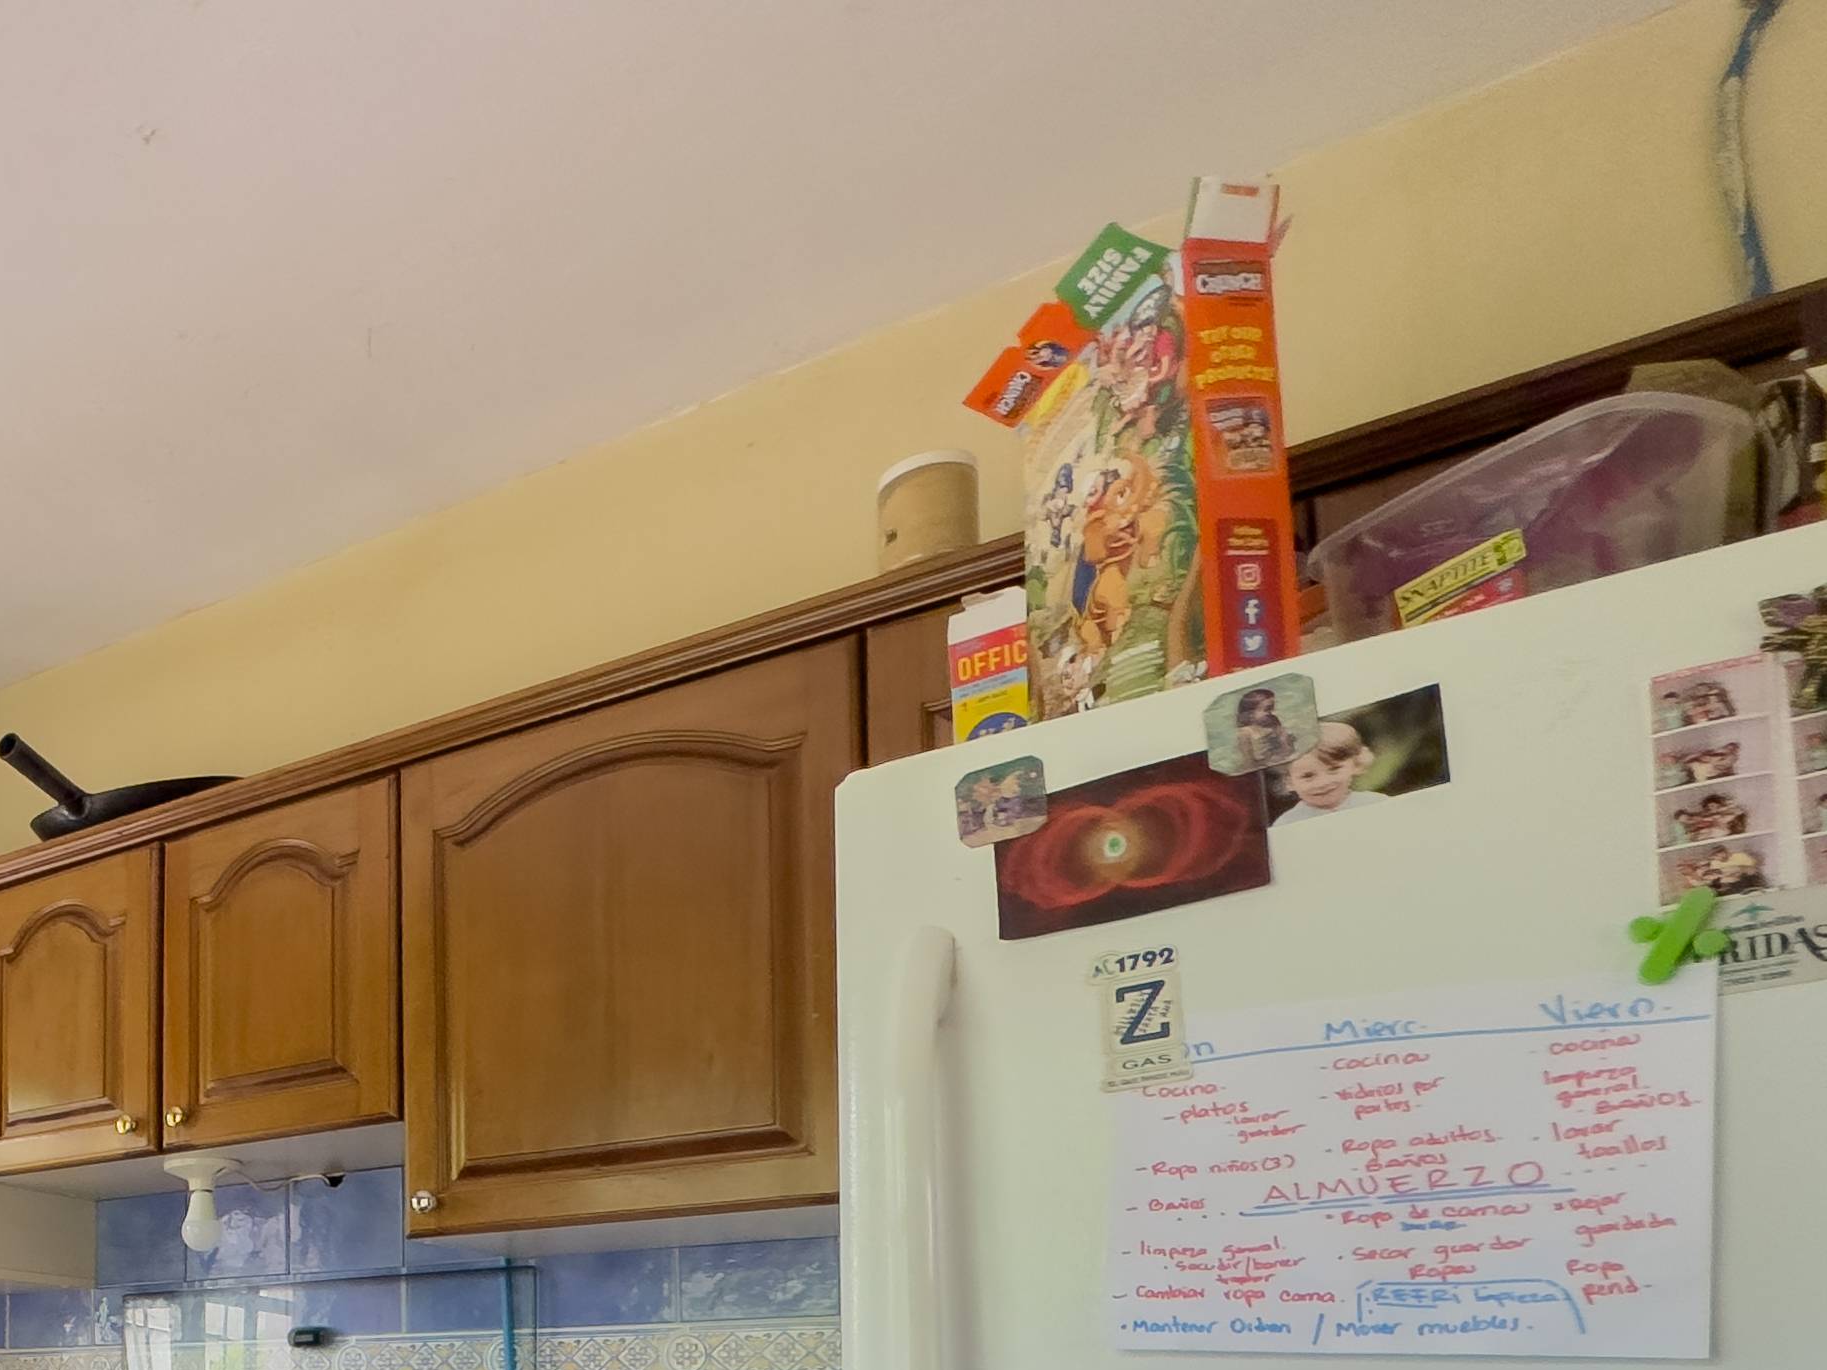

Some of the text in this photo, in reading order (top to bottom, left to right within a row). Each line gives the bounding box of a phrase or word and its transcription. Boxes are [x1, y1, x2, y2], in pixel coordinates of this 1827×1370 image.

[1076, 248, 1123, 296] SIZE
[1084, 247, 1153, 320] FAMILY
[957, 639, 1028, 682] OFFIC
[1122, 1053, 1172, 1071] GAS
[1262, 1160, 1546, 1205] ALMUERZO
